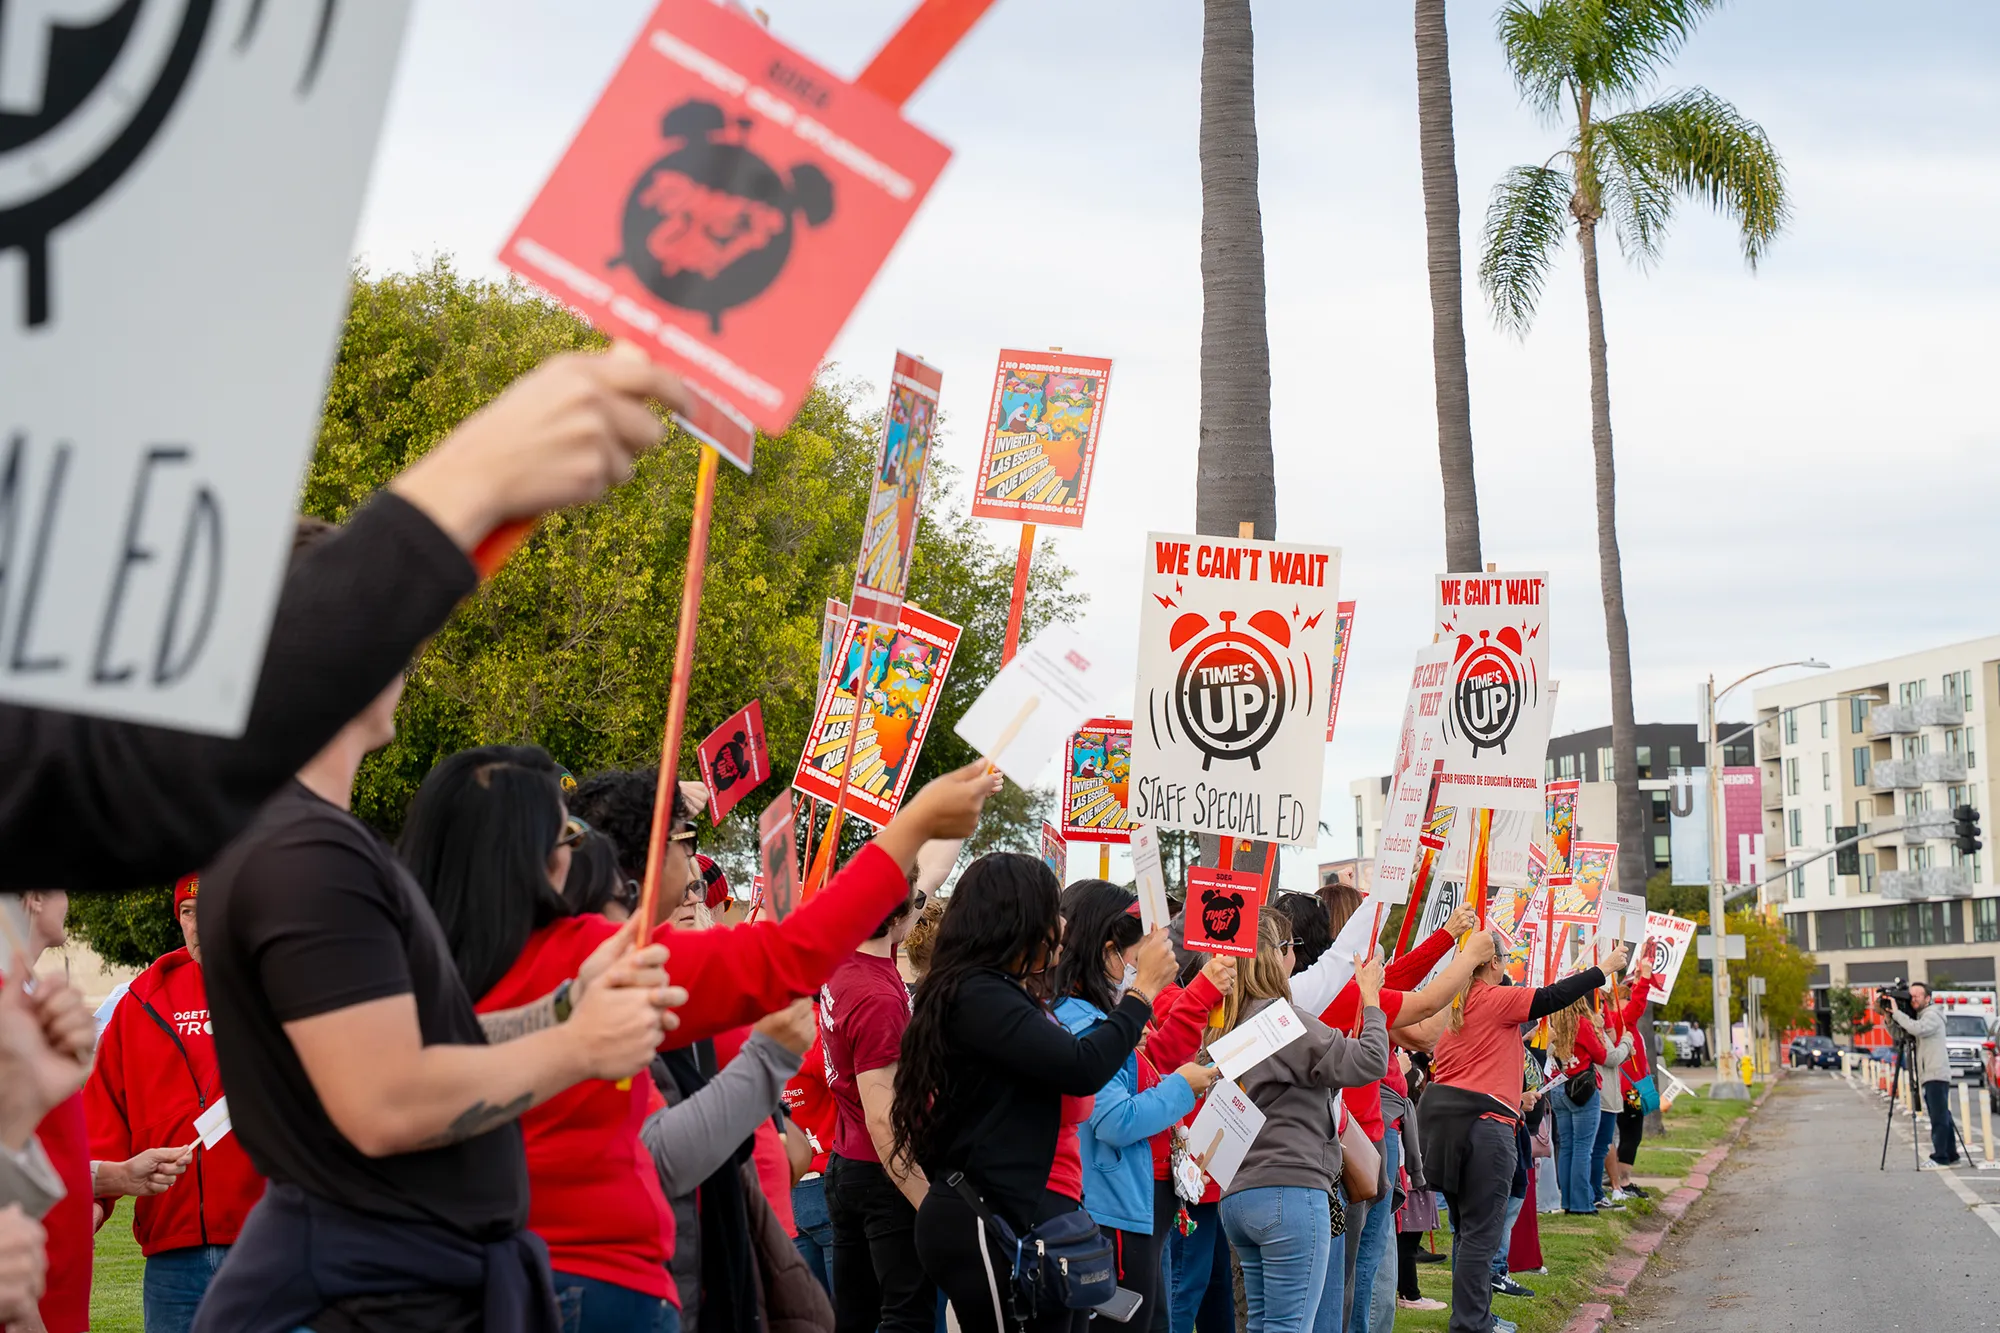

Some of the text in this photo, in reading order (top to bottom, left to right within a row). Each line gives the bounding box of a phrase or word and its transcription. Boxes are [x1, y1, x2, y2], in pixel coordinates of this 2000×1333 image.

[1005, 361, 1018, 369] NO
[1020, 362, 1061, 373] PODEMOS
[1062, 365, 1102, 377] ESPERAR
[994, 435, 1029, 454] INVIERTA
[988, 455, 1012, 479] LAS
[996, 475, 1019, 499] QUE
[1021, 502, 1063, 514] PODEMOS
[92, 445, 223, 685] ED
[1156, 541, 1329, 587] WE CAN'T WAIT
[1441, 579, 1542, 606] WE CAN'T WAIT
[910, 626, 949, 649] ESPERAR
[813, 678, 839, 738] PODEMOS
[834, 621, 858, 677] ESPERAR
[1199, 664, 1255, 686] TIME'S
[1422, 662, 1449, 687] CAN'T
[1469, 670, 1503, 691] TIME'S
[914, 677, 941, 739] PODEMOS
[1200, 685, 1264, 735] UP
[1419, 691, 1443, 717] WAIT
[1470, 687, 1508, 729] UP
[820, 723, 842, 744] LAS
[821, 747, 846, 772] QUE
[893, 740, 918, 797] ESPERAR
[1415, 757, 1427, 777] the
[1399, 782, 1422, 802] future
[1454, 774, 1476, 787] PUESTOS
[1477, 775, 1483, 787] DE
[1513, 777, 1538, 789] ESPECIAL
[1072, 797, 1087, 812] LAS
[1137, 776, 1187, 822] STAFF
[1194, 782, 1268, 836] SPECIAL
[1276, 794, 1304, 841] ED
[1078, 808, 1093, 826] QUE
[1384, 833, 1412, 853] students
[1739, 834, 1767, 884] H
[1216, 873, 1233, 881] SDEA
[1205, 908, 1235, 921] TIME'S
[1648, 915, 1656, 925] WE
[1674, 922, 1692, 933] WAIT
[1231, 1095, 1247, 1114] SDEA
